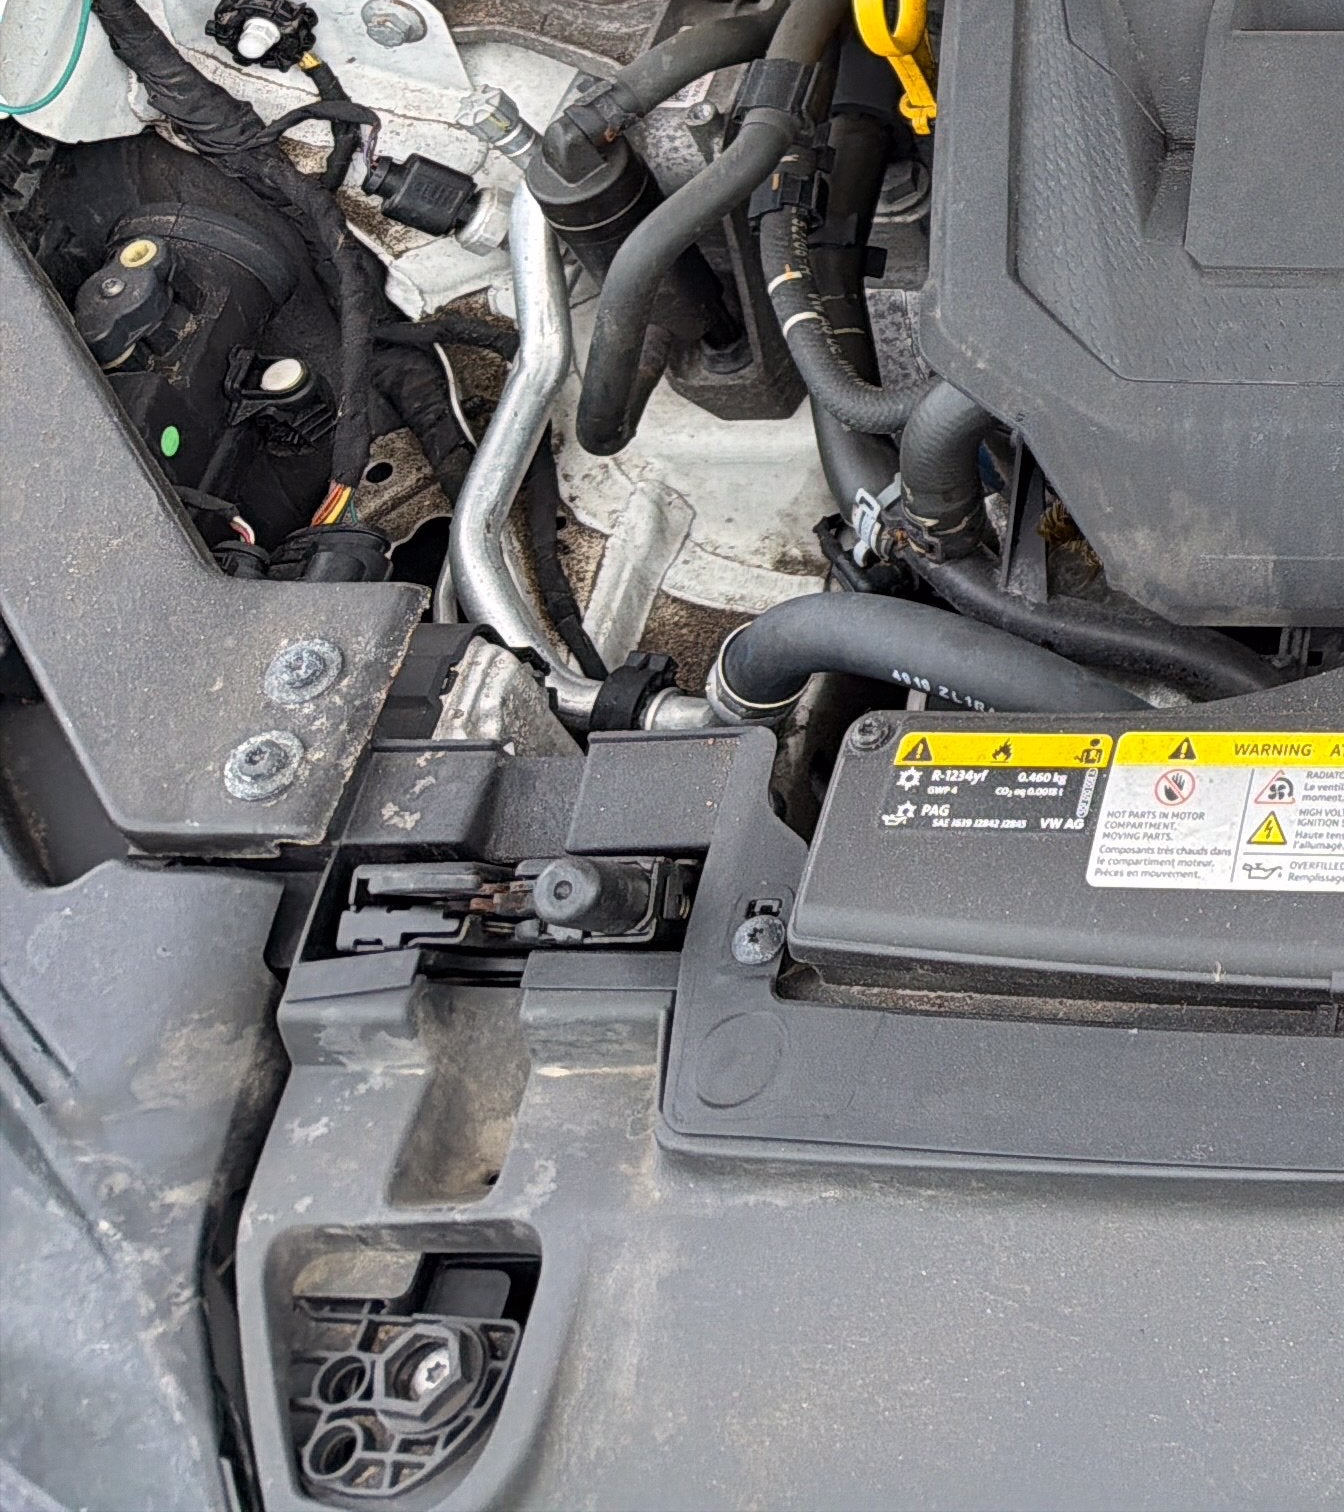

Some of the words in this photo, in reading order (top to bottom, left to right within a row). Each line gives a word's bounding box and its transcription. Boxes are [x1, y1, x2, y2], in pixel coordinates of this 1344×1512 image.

[1234, 743, 1312, 756] WARNING
[930, 769, 989, 785] R-1234yf
[1017, 772, 1051, 783] 0.460
[1053, 773, 1068, 785] kg
[927, 786, 950, 795] GWP
[921, 804, 950, 816] PAG
[1299, 808, 1322, 816] HIGH
[1040, 818, 1063, 829] VW
[1064, 818, 1085, 829] AG
[1297, 818, 1339, 827] IGNITION
